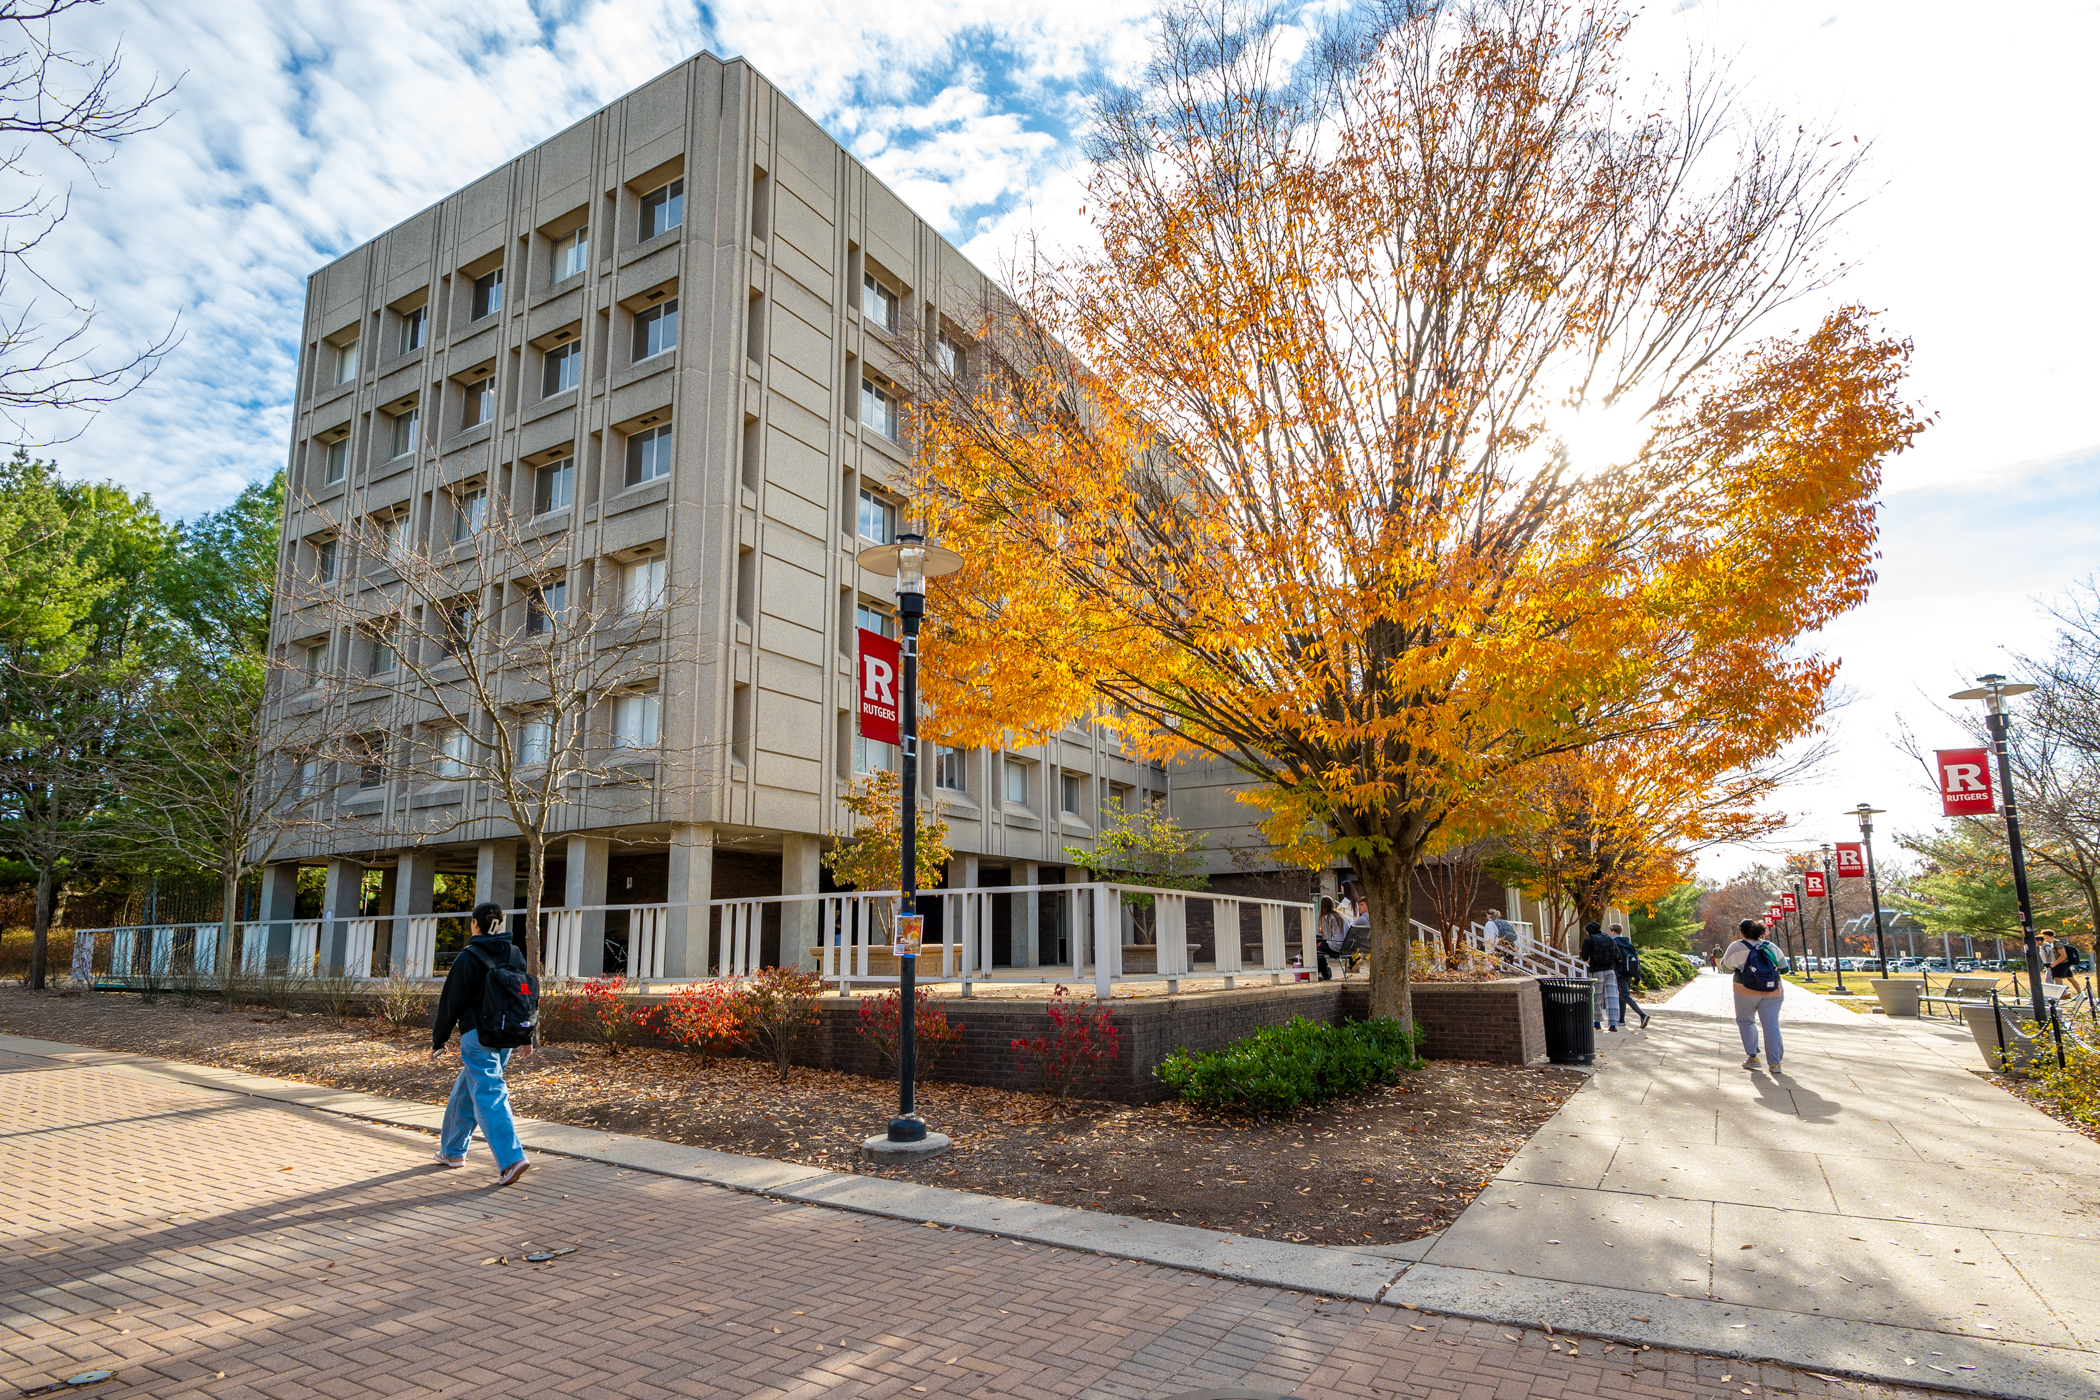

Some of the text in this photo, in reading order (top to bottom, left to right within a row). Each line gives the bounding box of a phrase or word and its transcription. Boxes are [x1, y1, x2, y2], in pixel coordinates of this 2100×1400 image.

[863, 654, 895, 706] R
[863, 702, 896, 722] RUTGERS
[1943, 763, 1986, 792] R
[1946, 793, 1988, 802] RUTGERS
[1839, 850, 1860, 865] R
[1807, 877, 1822, 888] R
[1783, 897, 1794, 905] R
[520, 983, 530, 991] R
